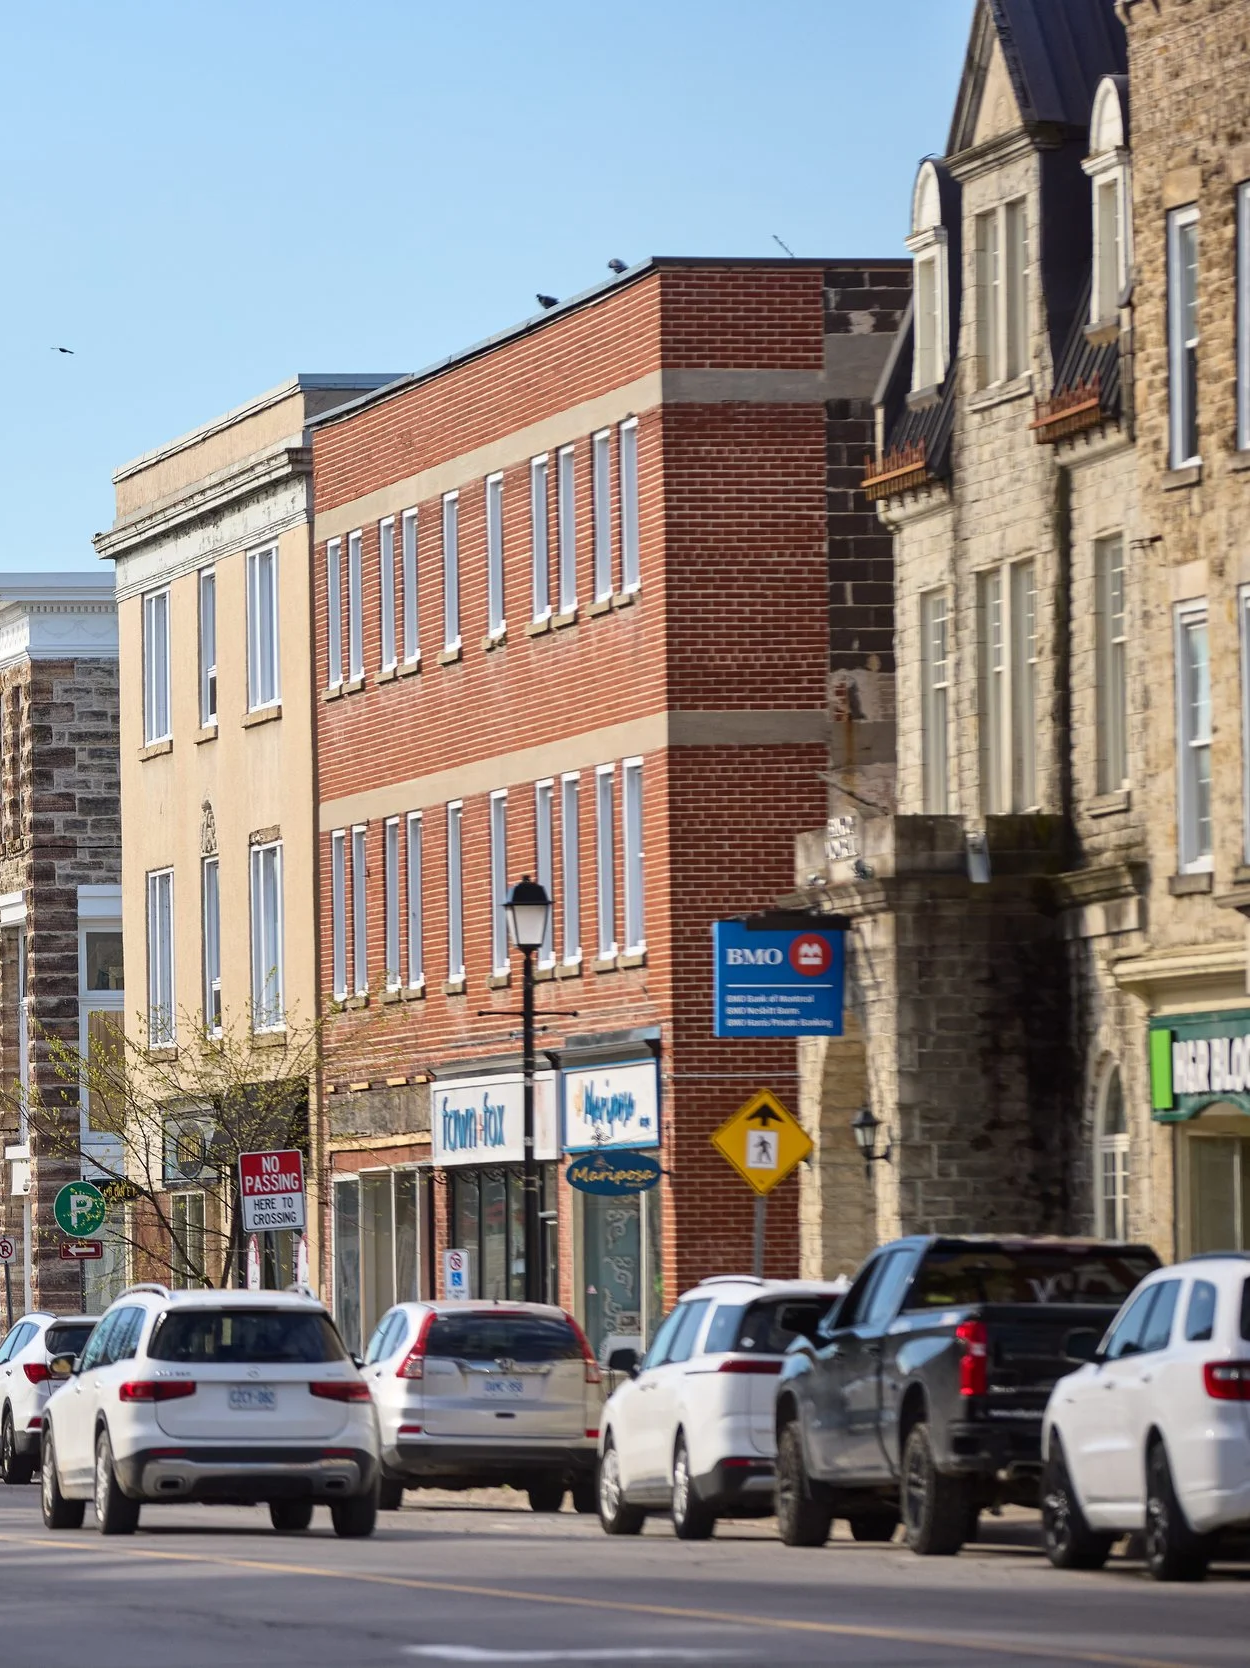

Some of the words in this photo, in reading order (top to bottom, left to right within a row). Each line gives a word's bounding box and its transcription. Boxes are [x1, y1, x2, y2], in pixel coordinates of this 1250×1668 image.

[726, 948, 784, 965] BMO
[1210, 1034, 1250, 1092] BLO
[262, 1156, 280, 1173] NO
[244, 1172, 300, 1193] PASSING
[254, 1198, 276, 1210] HERE
[282, 1197, 294, 1208] TO
[253, 1212, 297, 1226] CROSSING
